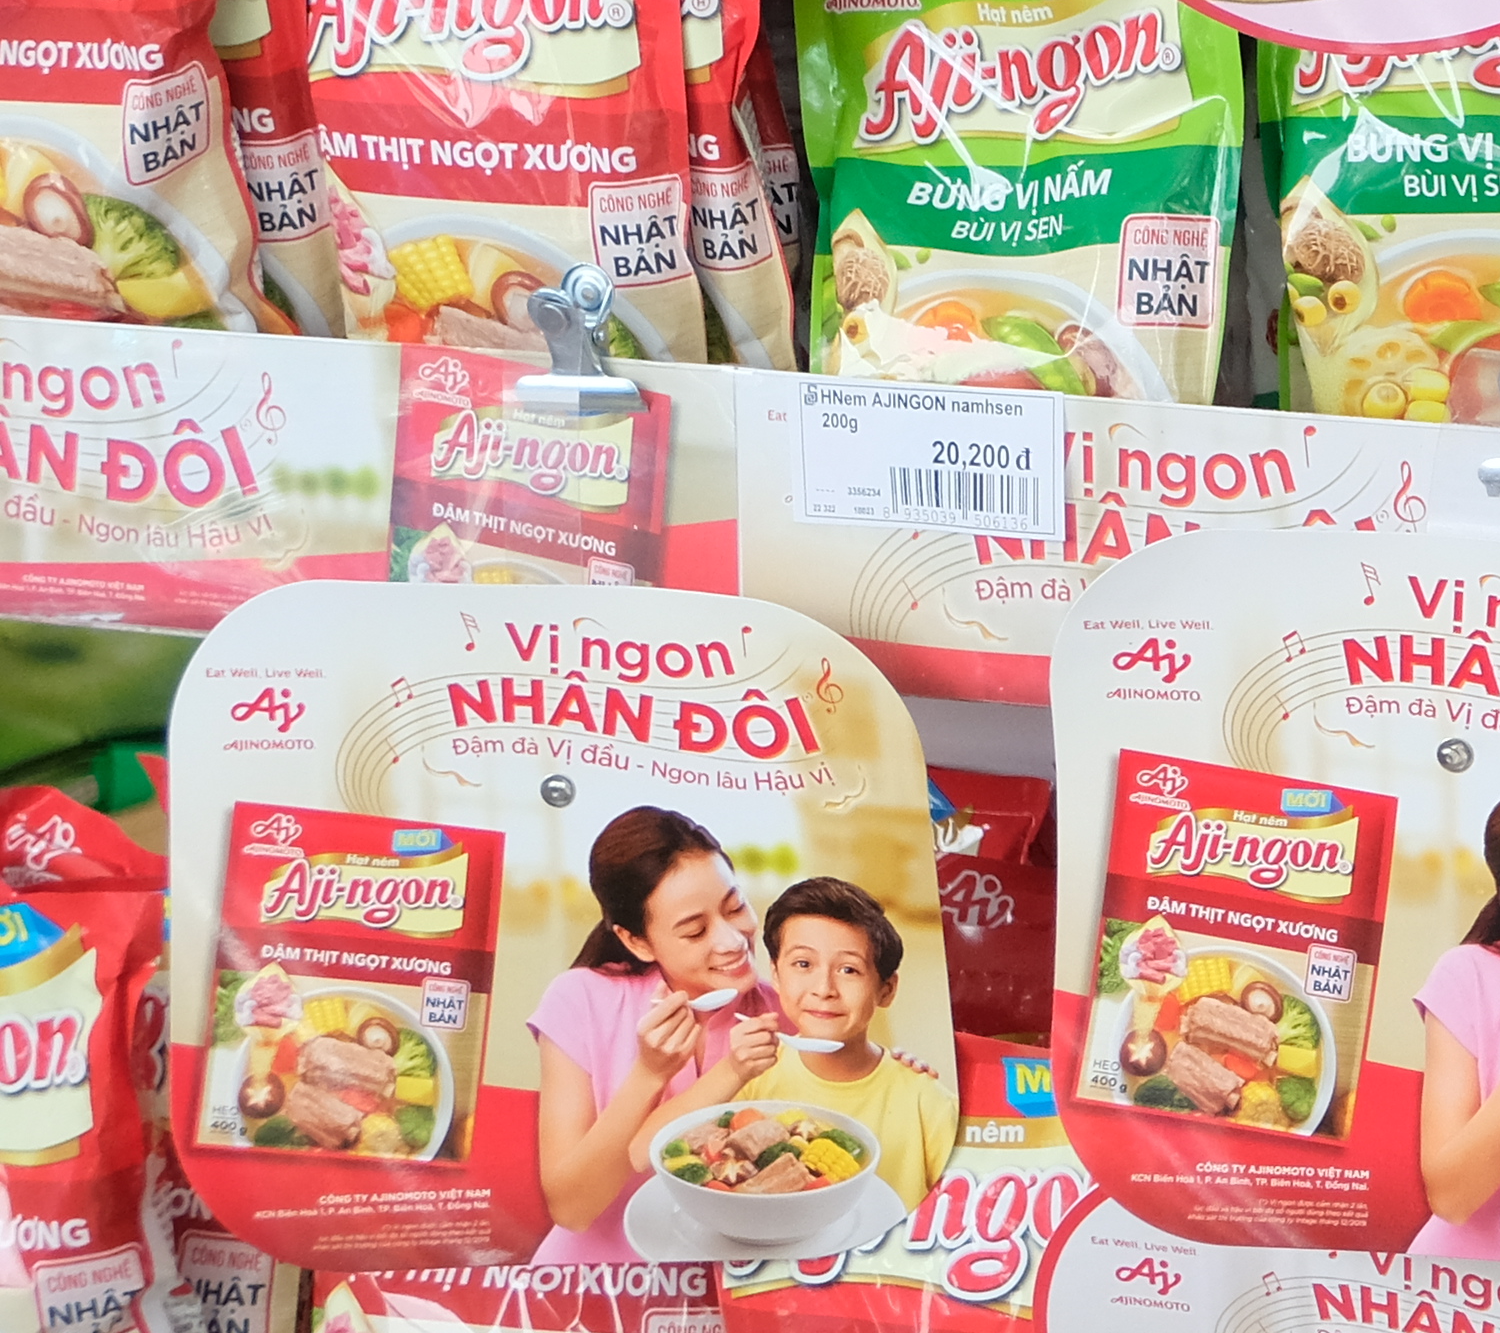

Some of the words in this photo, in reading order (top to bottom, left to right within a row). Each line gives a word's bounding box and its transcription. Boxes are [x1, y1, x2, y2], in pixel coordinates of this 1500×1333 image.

[977, 3, 1007, 25] Hạt
[1011, 6, 1053, 23] nêm
[360, 134, 424, 173] THỊT
[430, 140, 518, 176] NGỌT
[522, 140, 637, 174] XƯƠNG
[1015, 178, 1039, 215] VỊ
[1044, 159, 1112, 204] NẤM
[1404, 170, 1447, 198] BÙI
[1451, 174, 1479, 202] VỊ
[599, 192, 628, 213] CÔNG
[600, 215, 678, 251] NHẬT
[951, 216, 995, 242] BÙI
[999, 221, 1025, 247] VỊ
[1025, 215, 1064, 242] SEN
[1133, 228, 1166, 246] CÔNG
[614, 245, 677, 281] BẢN
[1127, 253, 1211, 291] NHẬT
[1136, 285, 1199, 317] BẢN
[821, 389, 867, 407] HNem
[872, 392, 946, 411] AJINGON
[951, 397, 1023, 416] namhsen
[822, 413, 858, 432] 200g
[932, 440, 1011, 471] 20,200
[1016, 447, 1032, 471] đ
[904, 509, 957, 525] 935039
[974, 514, 1029, 530] 506136
[1408, 575, 1466, 633] Vị
[1083, 620, 1105, 630] Eat
[1148, 619, 1175, 630] Live
[504, 622, 559, 675] Vị
[581, 635, 735, 684] ngon
[447, 670, 654, 744] NHÂN
[674, 689, 822, 760] ĐÔI
[1345, 695, 1400, 719] Đậm
[1408, 697, 1437, 718] đà
[1446, 700, 1474, 730] Vị
[452, 737, 504, 757] Đậm
[512, 737, 539, 756] đà
[547, 737, 571, 765] Vị
[581, 745, 630, 771] đầu
[651, 760, 709, 786] Ngon
[716, 771, 747, 790] lâu
[754, 770, 804, 795] Hậu
[808, 761, 836, 786] vị
[1147, 896, 1187, 916] ĐẬM
[1189, 902, 1224, 925] THỊT
[1227, 911, 1275, 933] NGỌT
[1278, 916, 1338, 943] XƯƠNG
[1093, 1059, 1120, 1072] HEO
[1091, 1074, 1118, 1087] 400
[1119, 1084, 1127, 1093] g
[1232, 1164, 1246, 1174] TY
[1248, 1165, 1315, 1178] AJINOMOTO
[1344, 1169, 1370, 1179] NAM
